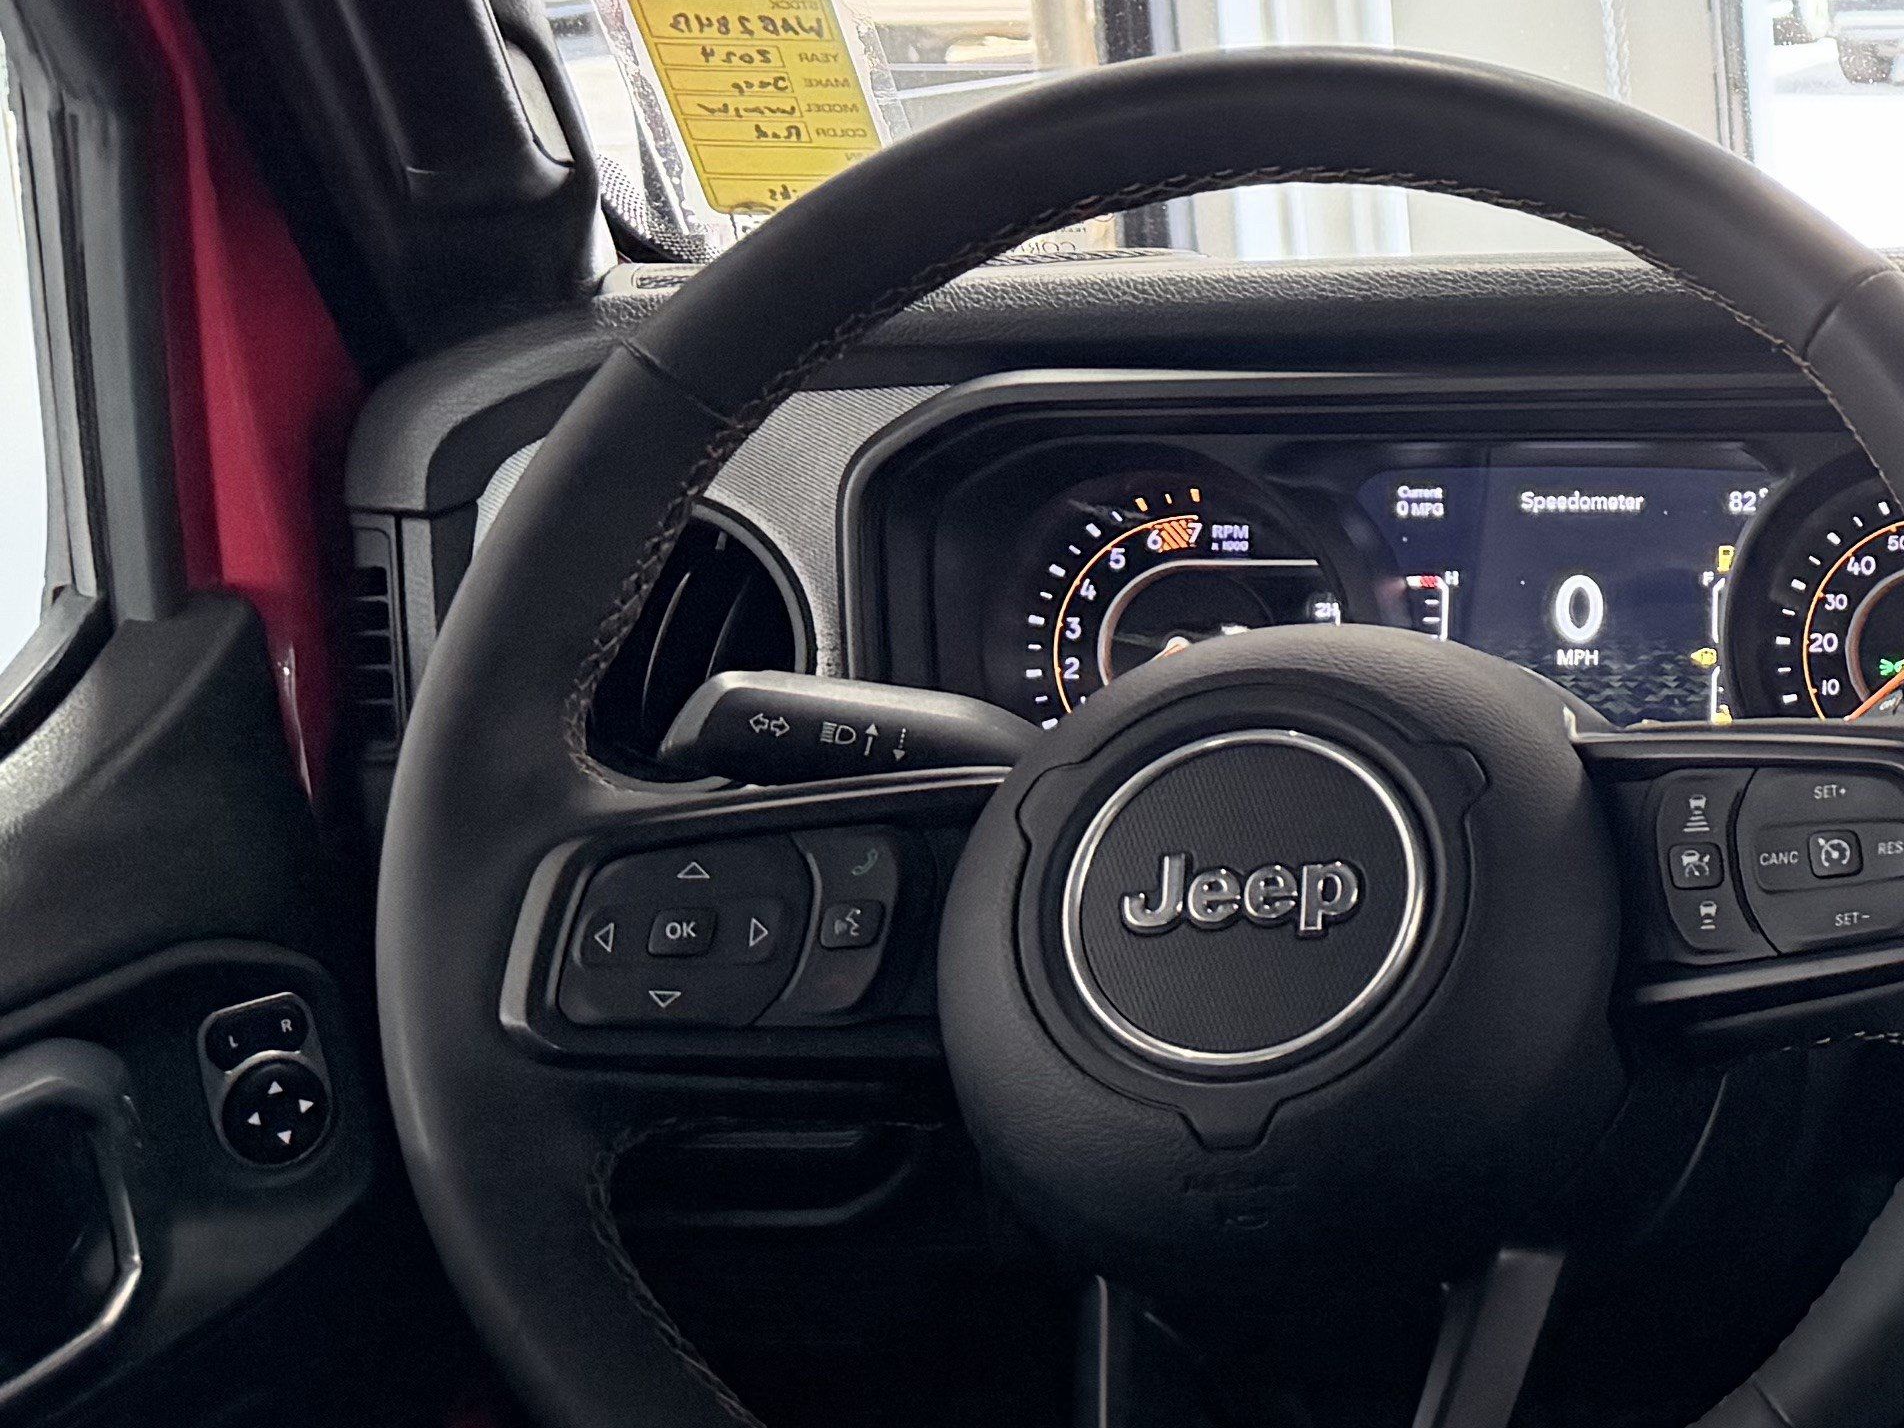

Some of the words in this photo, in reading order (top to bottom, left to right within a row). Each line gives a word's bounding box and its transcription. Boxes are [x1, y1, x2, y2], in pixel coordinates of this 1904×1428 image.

[1397, 485, 1443, 499] Current
[1411, 501, 1445, 517] MPG
[1520, 490, 1645, 514] Speedometer
[1146, 528, 1163, 551] 6
[1211, 524, 1250, 539] RPM
[1108, 547, 1126, 570] 5
[1846, 555, 1877, 576] 40
[1444, 571, 1460, 586] H
[1080, 578, 1097, 601] 4
[1554, 573, 1605, 644] 0
[1823, 593, 1848, 611] 30
[1065, 616, 1082, 639] 3
[1808, 632, 1839, 653] 20
[1556, 648, 1600, 666] MPH
[1063, 656, 1080, 680] 2
[1821, 678, 1840, 695] 10
[1814, 784, 1847, 800] SET+
[1877, 840, 1904, 856] RES
[1759, 851, 1799, 866] CANC
[1121, 852, 1361, 933] Jeep
[664, 921, 697, 940] OK
[280, 1018, 293, 1033] R
[228, 1034, 239, 1049] L
